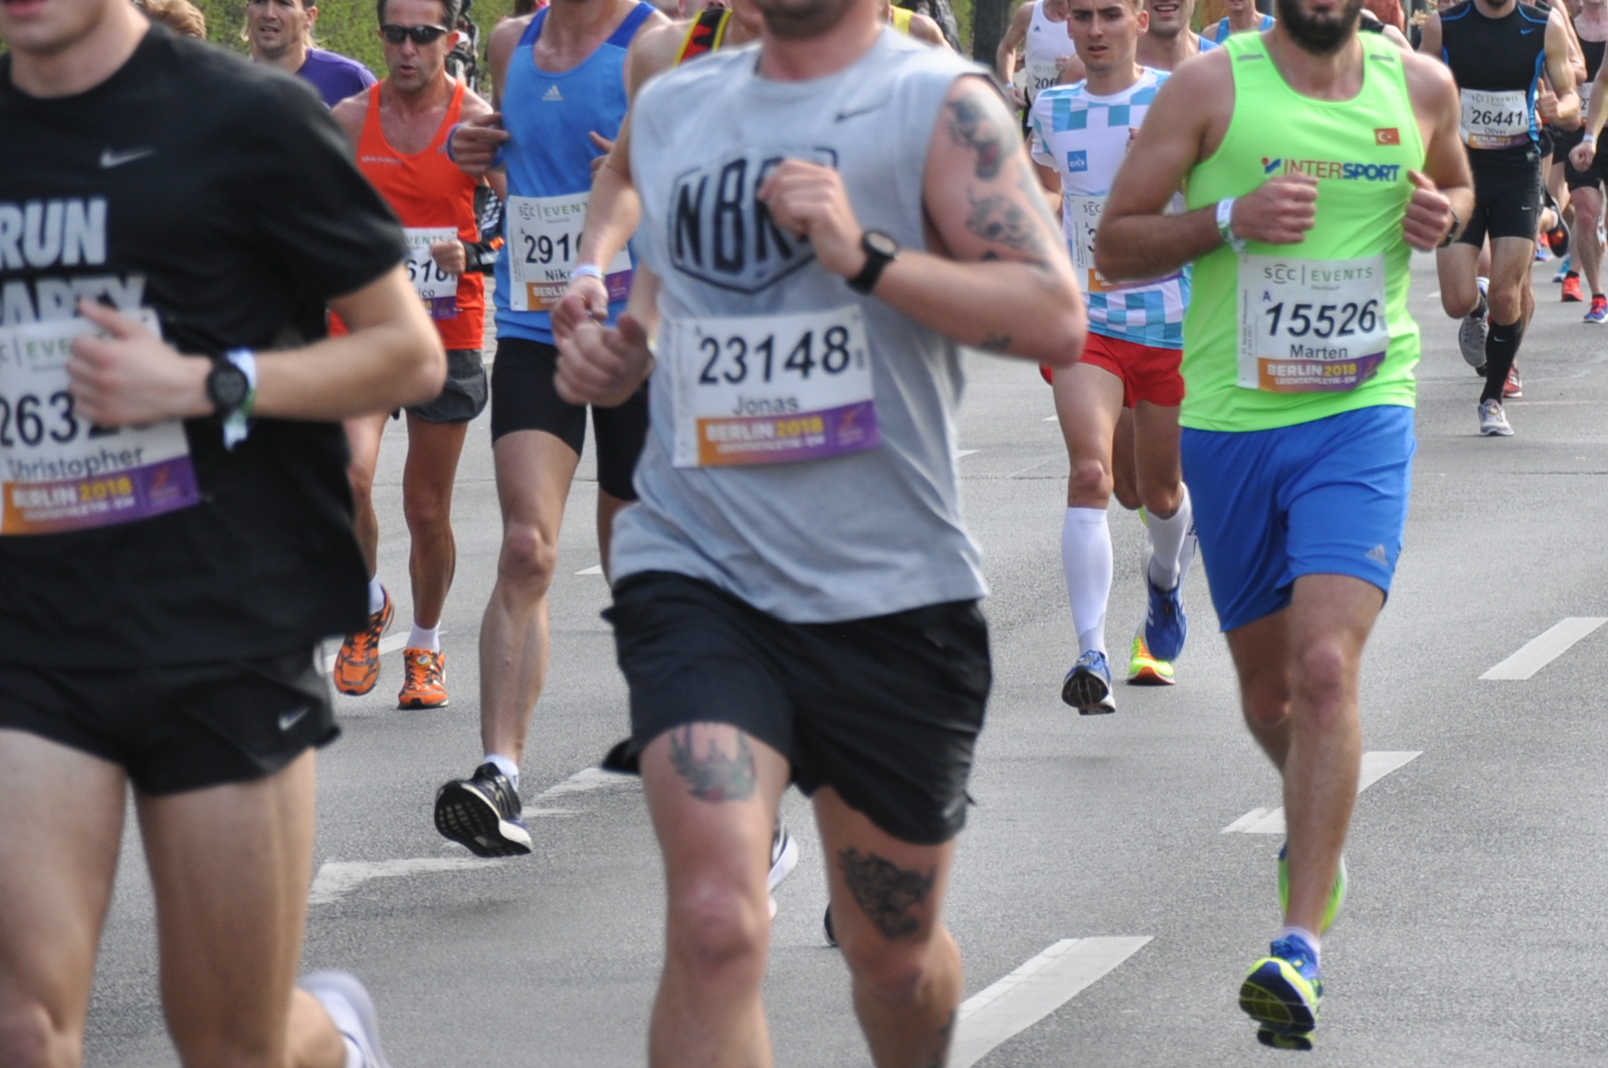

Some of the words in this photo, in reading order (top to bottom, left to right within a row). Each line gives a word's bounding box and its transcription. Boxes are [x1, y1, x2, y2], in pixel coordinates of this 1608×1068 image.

[1471, 109, 1523, 127] 26441
[1284, 158, 1401, 183] INTERSPORT
[544, 202, 589, 217] EVENT
[675, 156, 809, 276] NBR
[0, 198, 107, 270] RUN
[406, 235, 446, 246] VENTS
[524, 232, 583, 265] 291
[1263, 264, 1296, 285] SCC
[1310, 267, 1373, 283] EVENTS
[1265, 298, 1378, 339] 15526
[698, 325, 852, 385] 23148
[1290, 344, 1349, 360] Marten
[1267, 363, 1323, 377] BERLIN
[1323, 362, 1357, 377] 2018
[732, 395, 799, 417] Jonas
